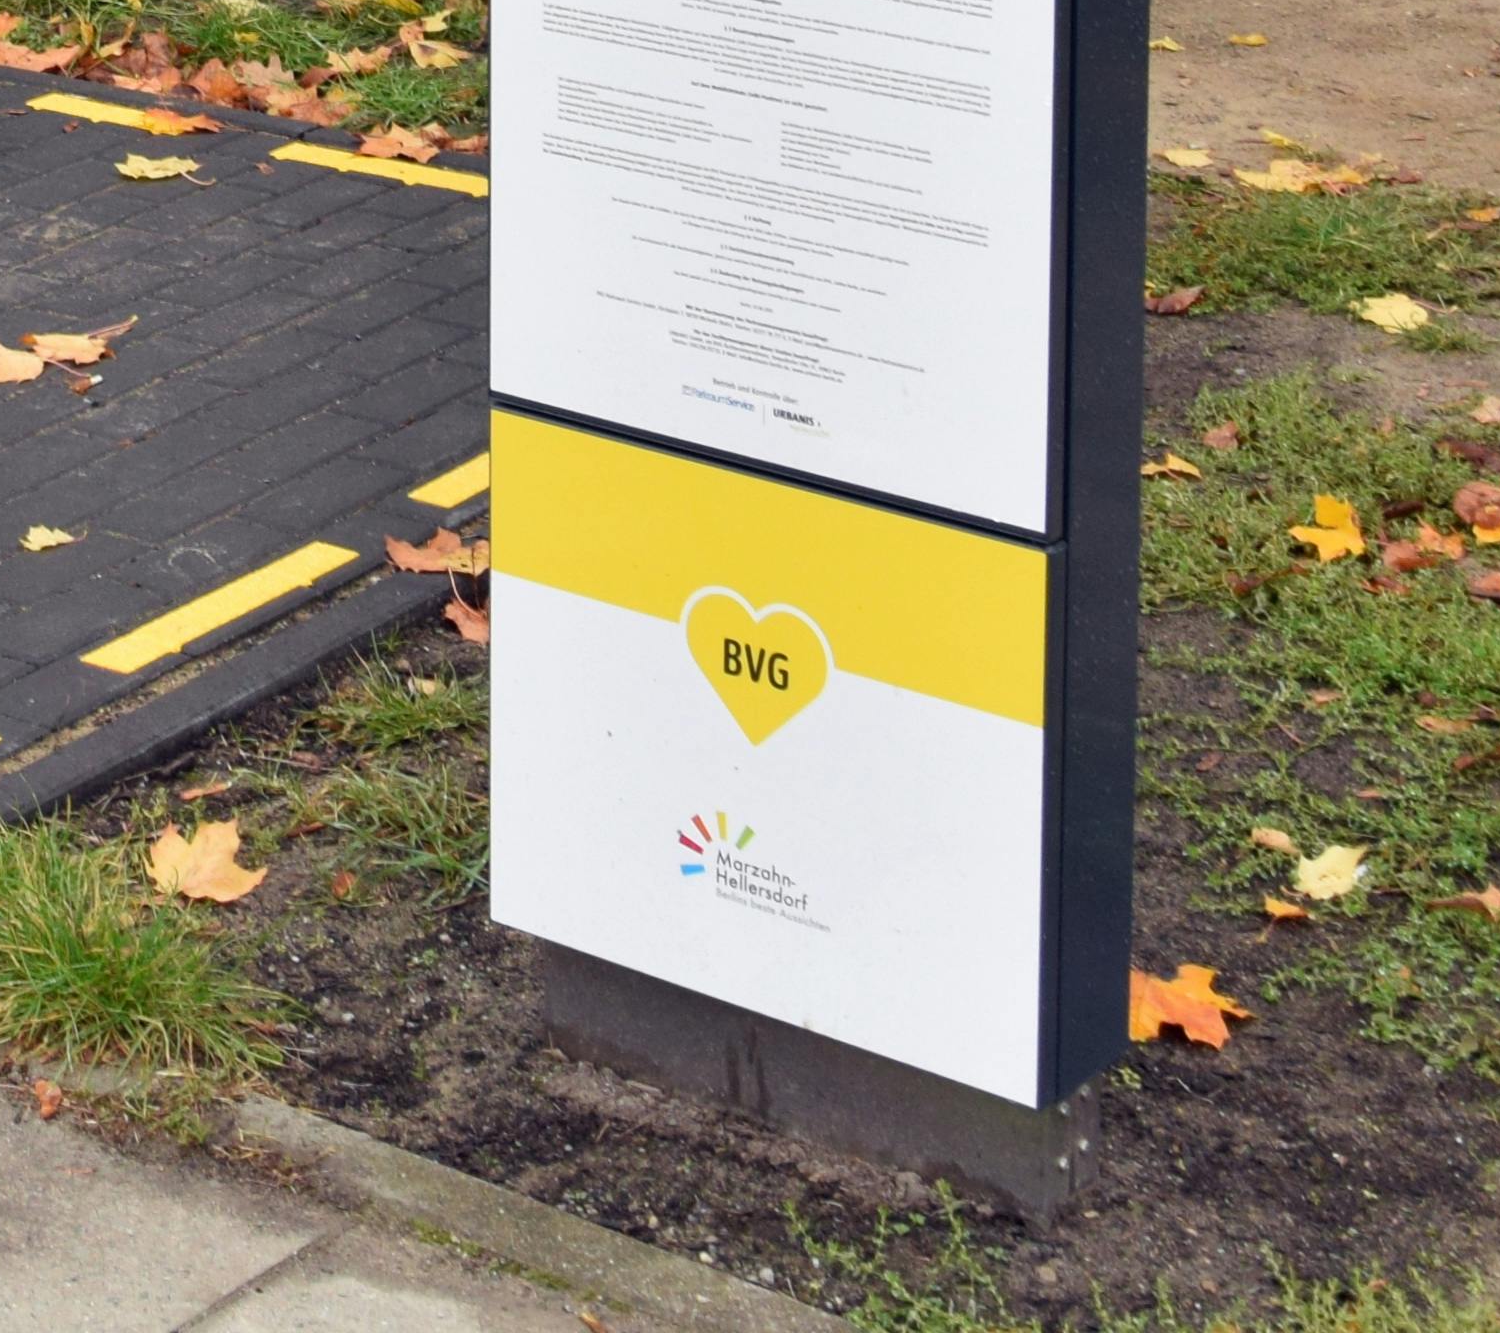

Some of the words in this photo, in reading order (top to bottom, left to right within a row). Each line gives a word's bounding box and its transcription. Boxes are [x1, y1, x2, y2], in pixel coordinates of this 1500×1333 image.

[723, 637, 789, 691] BVG
[716, 849, 797, 887] Marzahn-
[716, 866, 808, 911] Hellersdorf
